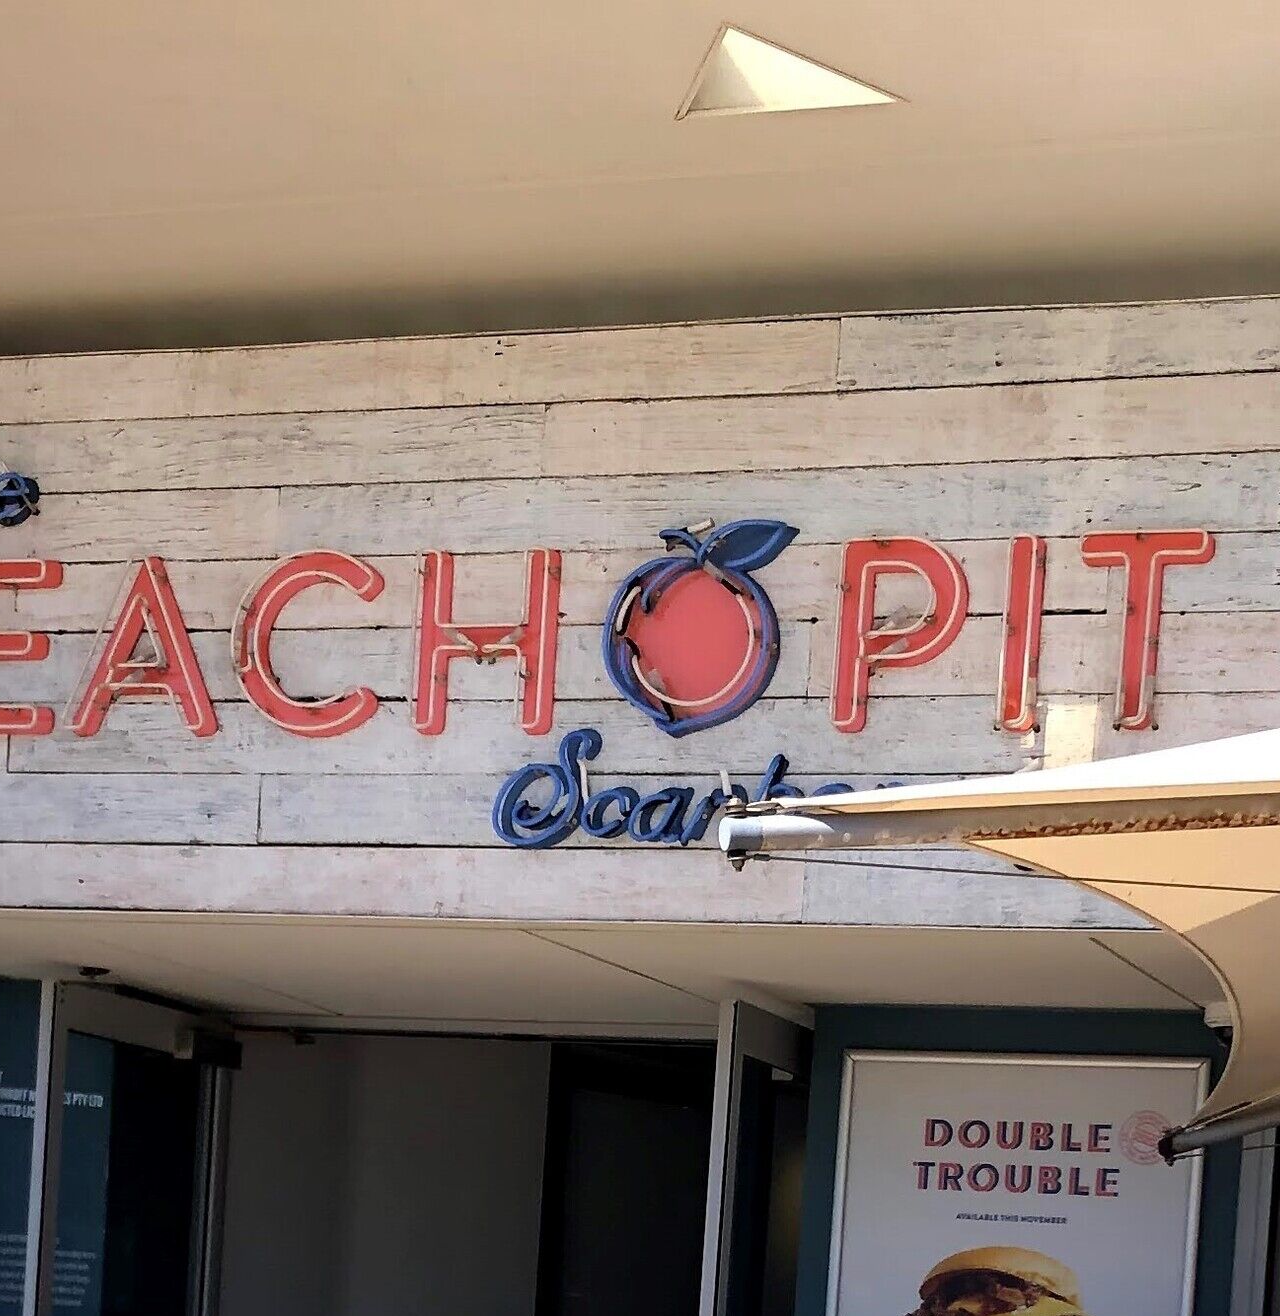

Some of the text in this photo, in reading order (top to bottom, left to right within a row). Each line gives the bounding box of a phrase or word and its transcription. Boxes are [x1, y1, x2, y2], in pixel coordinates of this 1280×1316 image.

[829, 529, 1216, 734] PIT
[924, 1118, 1114, 1153] DOUBLE
[913, 1161, 1121, 1198] TROUBLE
[955, 1213, 1068, 1225] AVAILABLE THIS NOVEMBER
